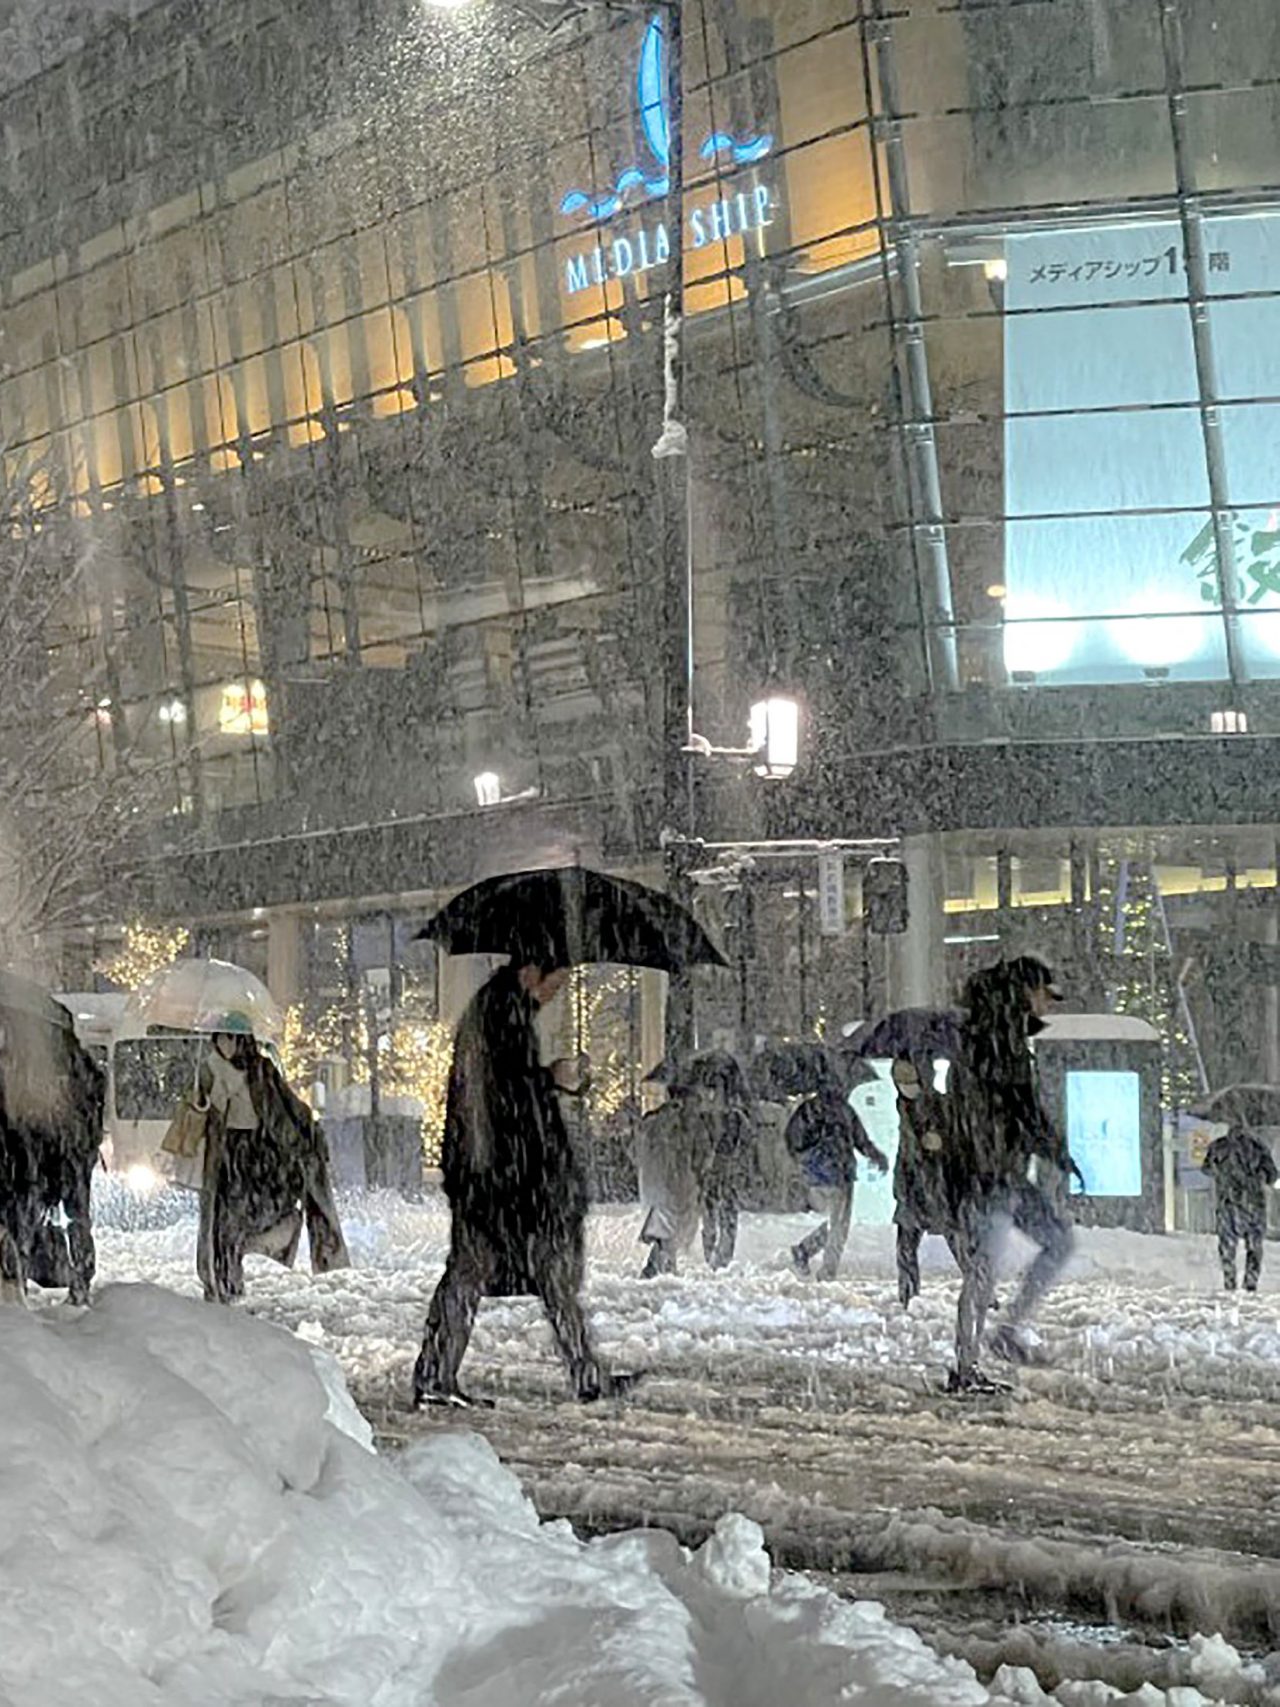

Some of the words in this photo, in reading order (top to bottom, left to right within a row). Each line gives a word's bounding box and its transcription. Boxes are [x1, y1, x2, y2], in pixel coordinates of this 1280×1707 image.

[691, 186, 774, 248] SHIP
[1030, 246, 1230, 283] メディアシップ1階
